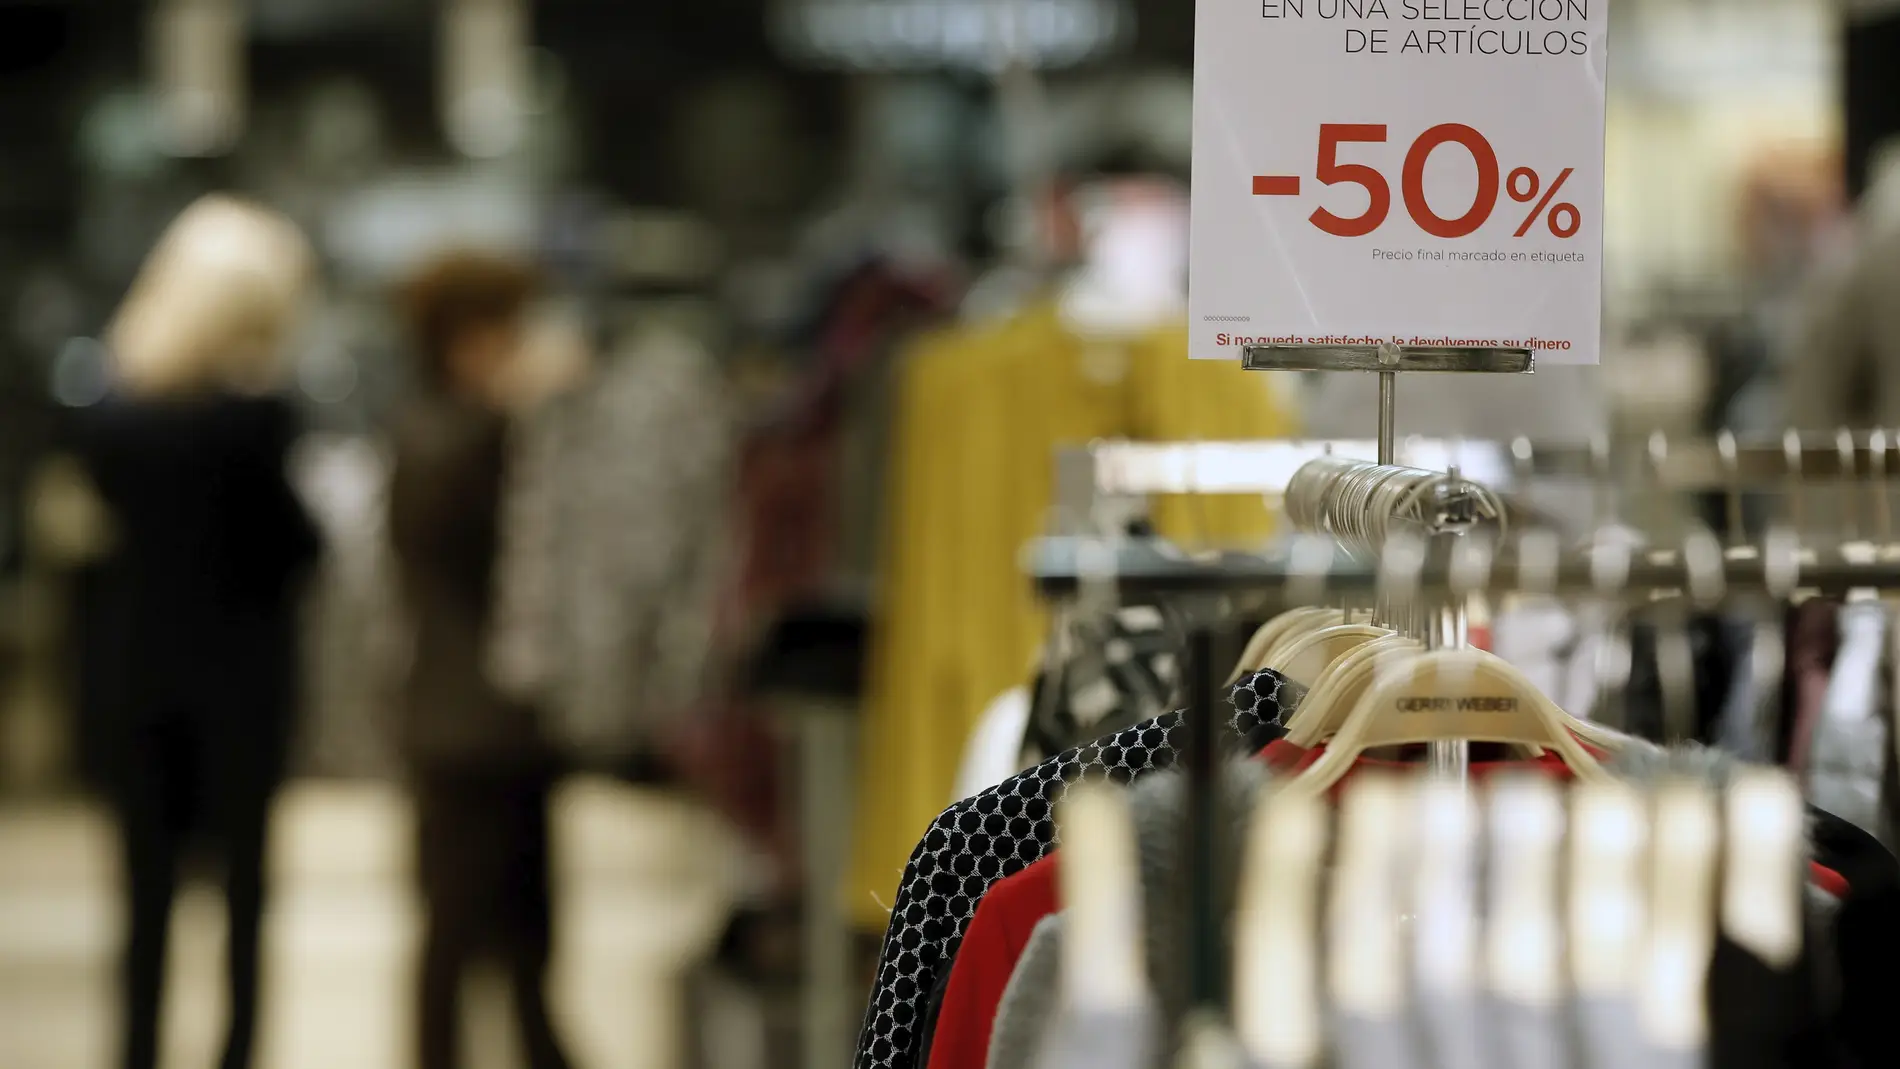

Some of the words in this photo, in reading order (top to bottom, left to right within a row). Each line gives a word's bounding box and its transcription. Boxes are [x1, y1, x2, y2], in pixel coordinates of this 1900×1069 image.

[1262, 0, 1304, 19] EN
[1317, 0, 1390, 20] UNA
[1345, 29, 1388, 54] DE
[1400, 24, 1588, 56] ARTÍCULOS
[1252, 122, 1582, 239] -50%
[1371, 248, 1414, 261] Precio
[1417, 248, 1444, 261] final
[1448, 249, 1507, 262] marcado
[1510, 252, 1527, 262] en
[1530, 251, 1585, 265] etiqueta
[1216, 333, 1230, 346] Si
[1234, 336, 1253, 346] no
[1524, 337, 1571, 350] dinero
